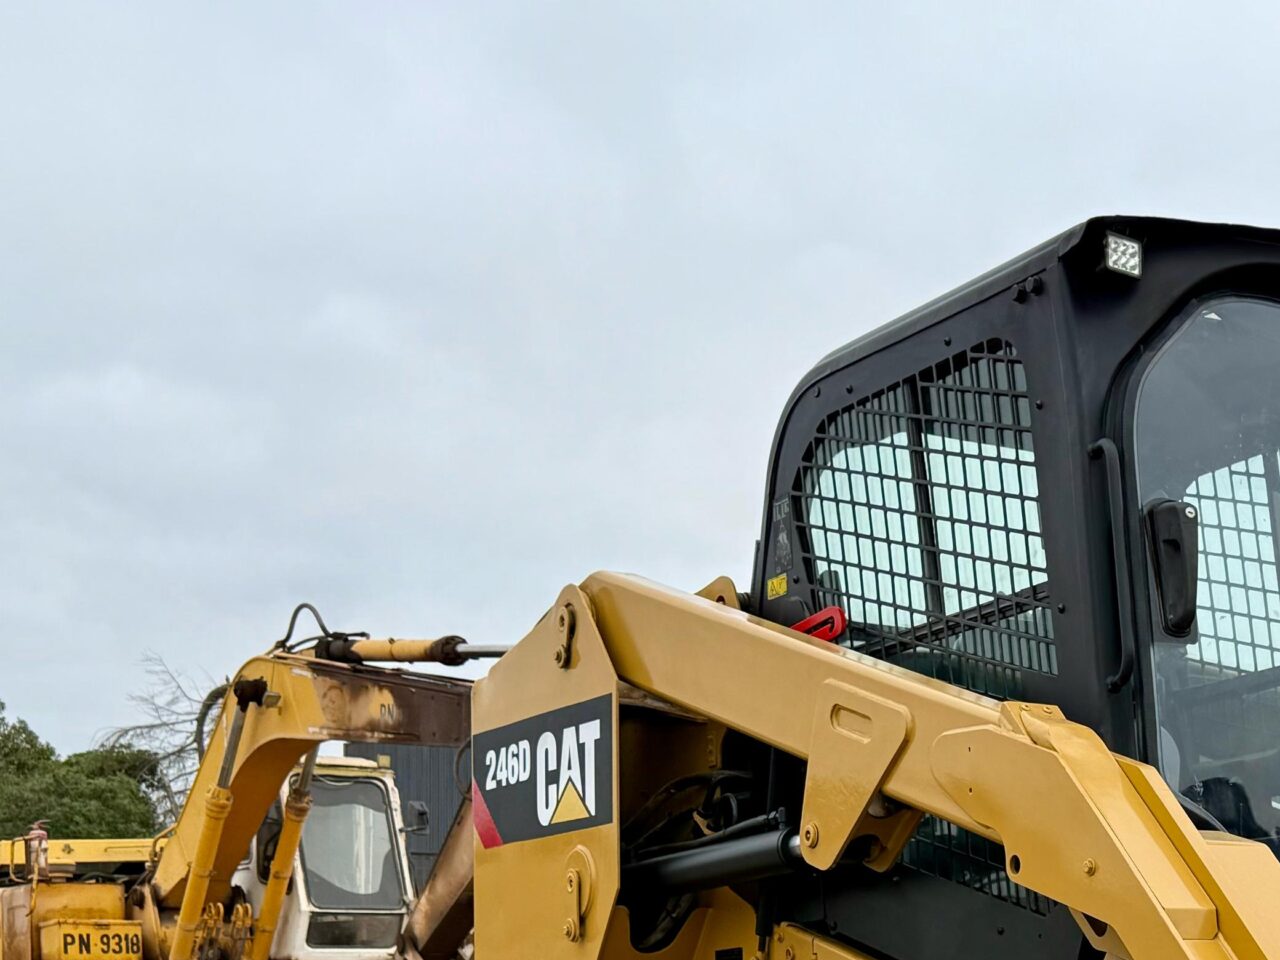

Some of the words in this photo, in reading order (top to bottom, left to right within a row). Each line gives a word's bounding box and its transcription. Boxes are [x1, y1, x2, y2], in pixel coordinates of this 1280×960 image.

[485, 739, 531, 791] 246D
[536, 718, 601, 826] CAT
[63, 933, 91, 954] PN
[100, 933, 141, 954] 9318
